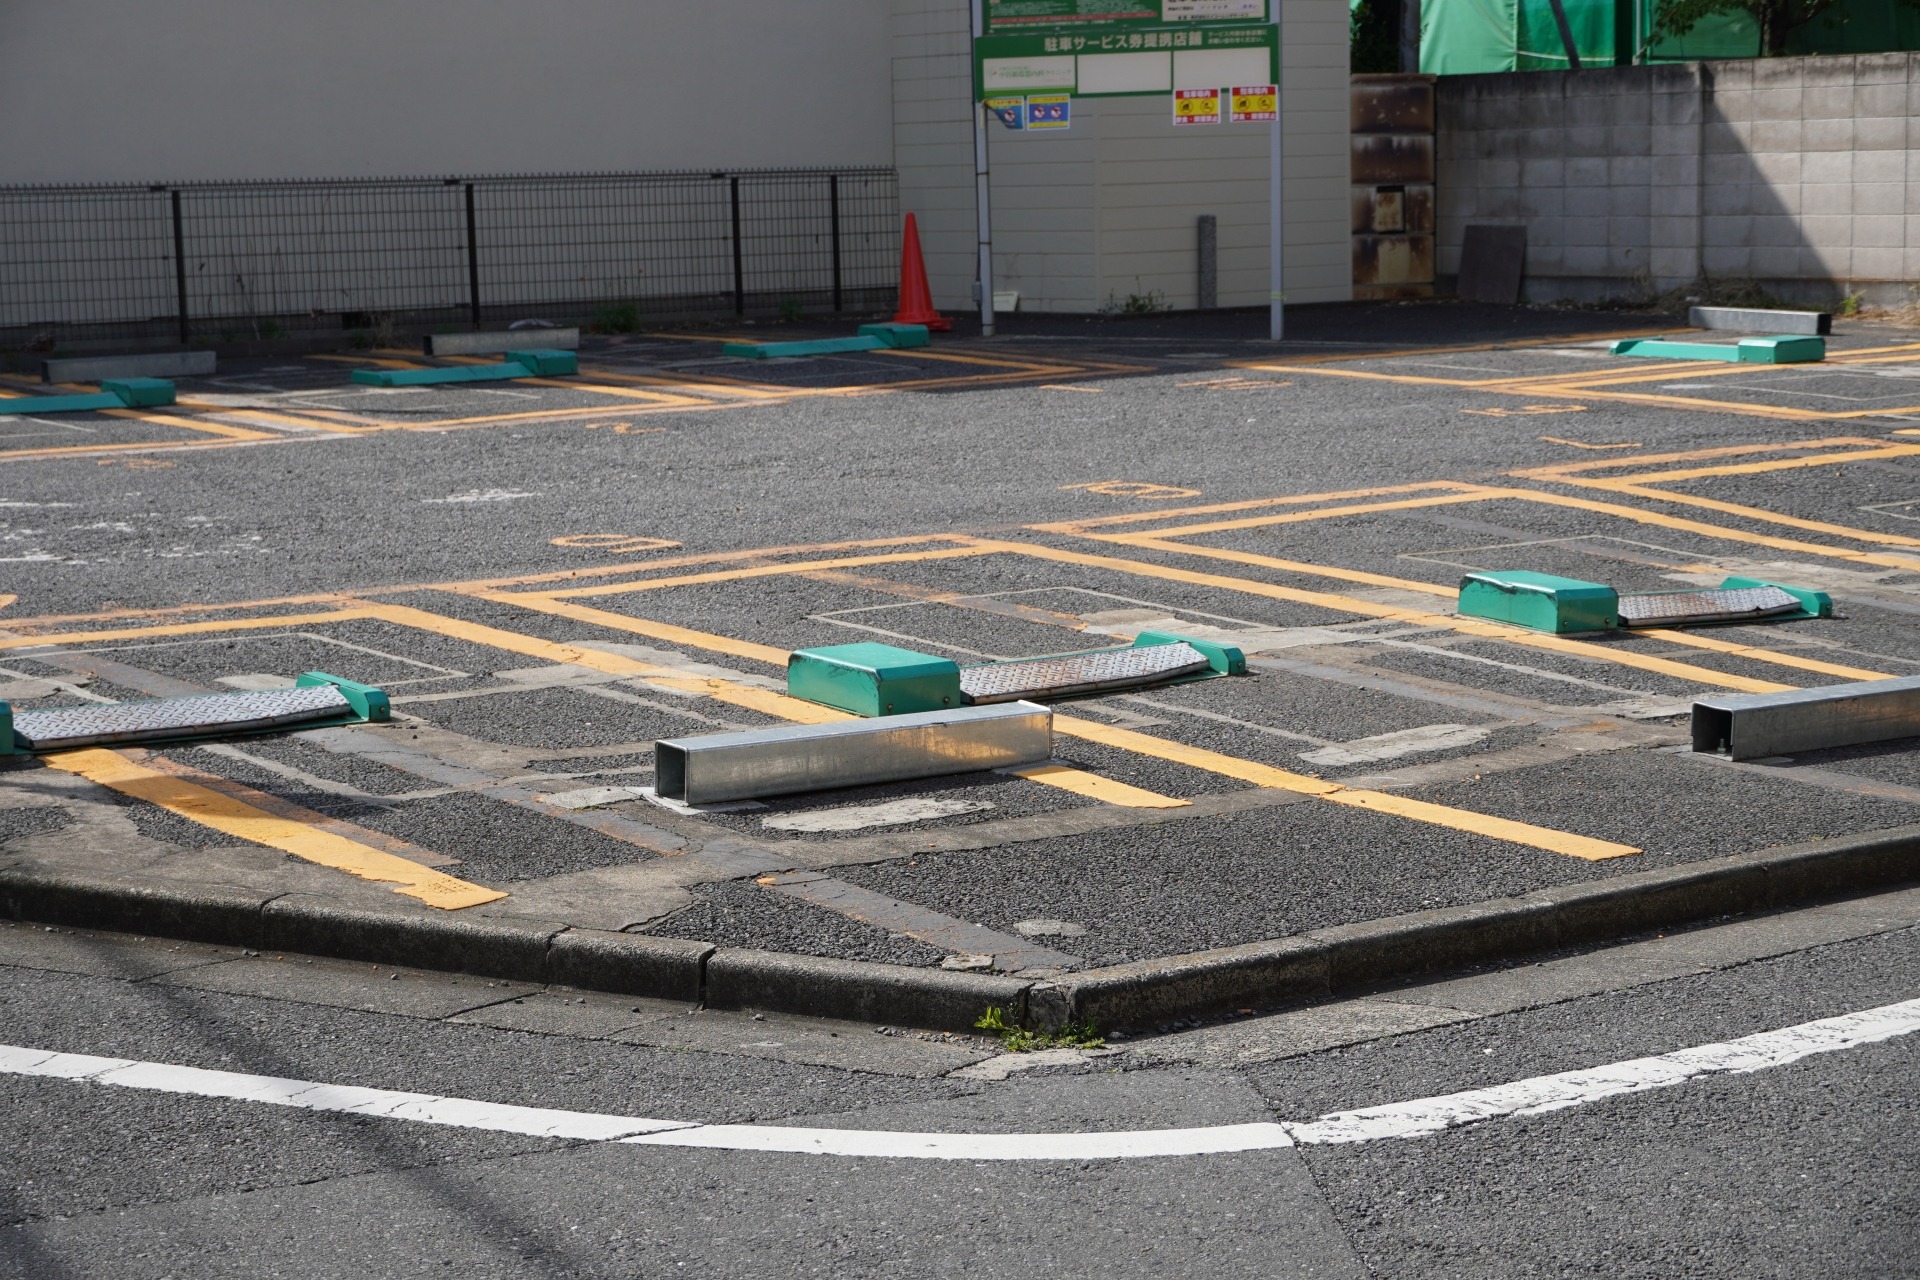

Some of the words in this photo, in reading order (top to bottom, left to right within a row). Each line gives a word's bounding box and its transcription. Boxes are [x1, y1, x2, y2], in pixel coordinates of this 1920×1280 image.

[1044, 31, 1202, 52] 駐車サービス券提携店舗
[550, 534, 683, 553] 5
